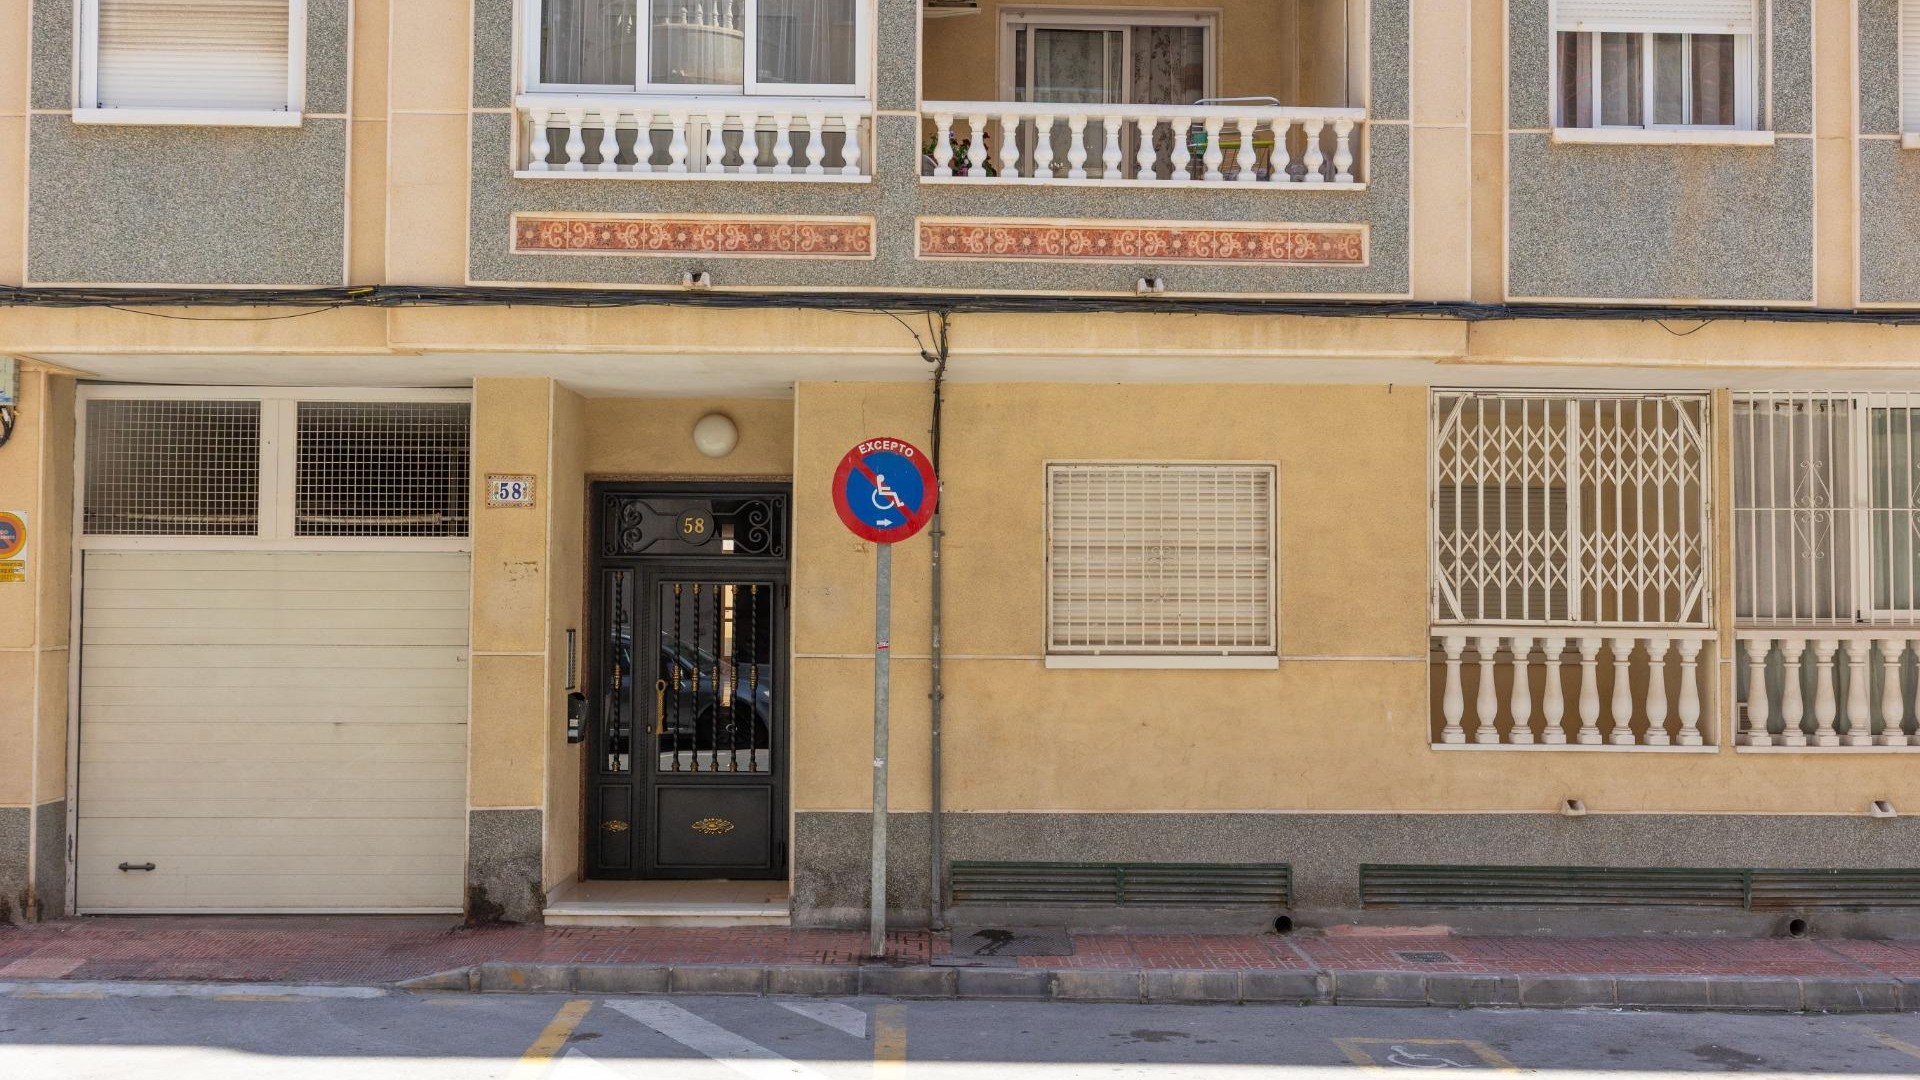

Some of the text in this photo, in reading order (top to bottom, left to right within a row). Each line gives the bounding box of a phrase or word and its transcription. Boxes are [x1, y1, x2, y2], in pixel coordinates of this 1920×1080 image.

[858, 440, 914, 458] EXCEPTO
[499, 482, 521, 500] 58
[683, 517, 705, 534] 58
